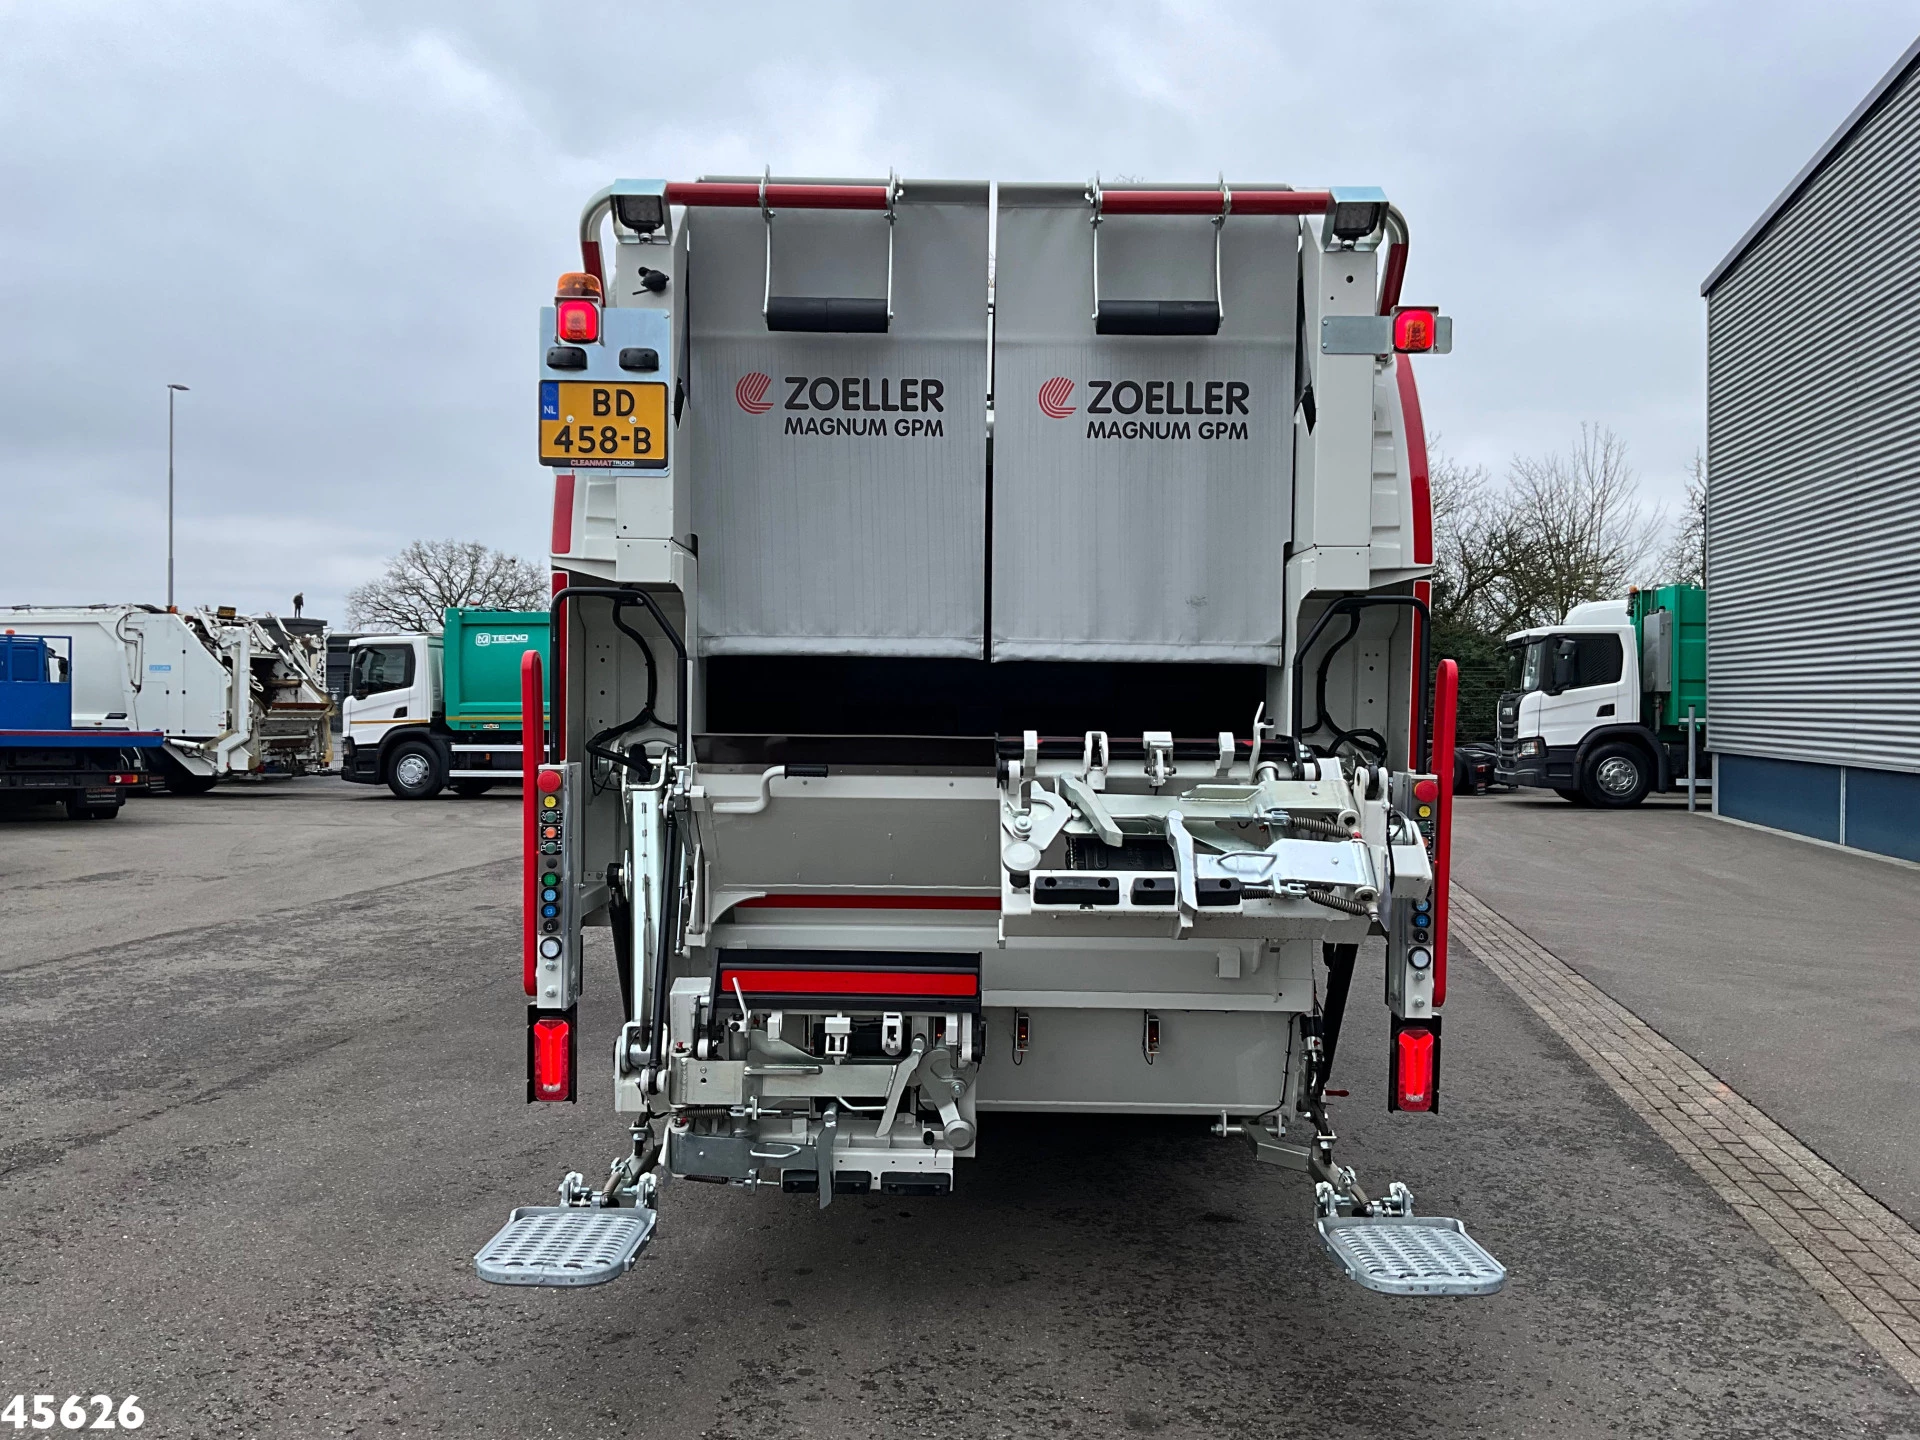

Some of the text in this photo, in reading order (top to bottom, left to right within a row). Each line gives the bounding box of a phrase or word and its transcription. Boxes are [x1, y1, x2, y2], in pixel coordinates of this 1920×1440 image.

[592, 388, 635, 417] BD
[784, 376, 944, 413] ZOELLER
[1087, 380, 1250, 415] ZOELLER
[543, 405, 557, 415] NL
[553, 425, 652, 454] 458-B
[784, 416, 944, 438] MAGNUM GPM
[1086, 420, 1249, 440] MAGNUM GPM
[491, 634, 529, 642] TECNO
